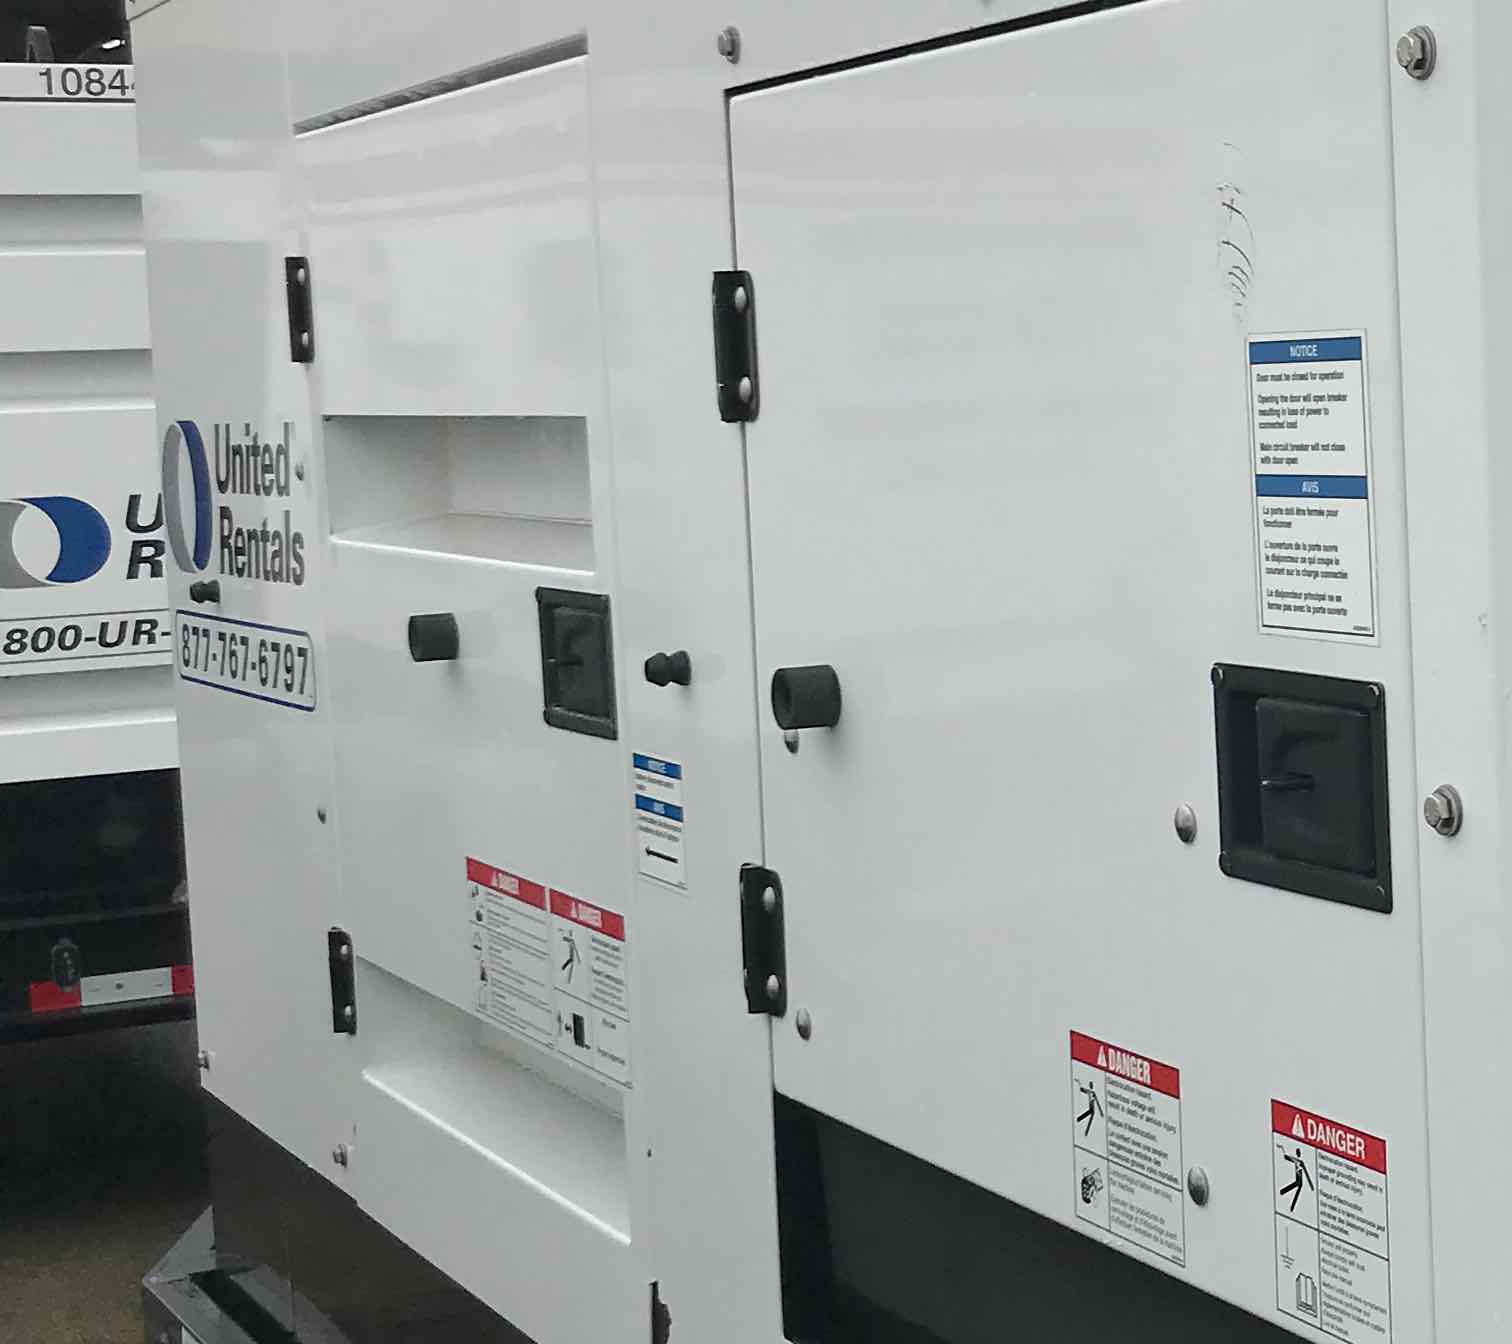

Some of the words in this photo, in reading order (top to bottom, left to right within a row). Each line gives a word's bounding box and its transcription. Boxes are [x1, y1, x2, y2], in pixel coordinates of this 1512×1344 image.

[39, 67, 136, 96] 1084
[1290, 345, 1319, 357] NOTICE
[214, 421, 291, 497] United
[219, 506, 304, 586] Rentals
[181, 623, 309, 696] 877-767-6797
[1108, 1046, 1152, 1085] DANGER
[1307, 1117, 1367, 1160] DANGER
